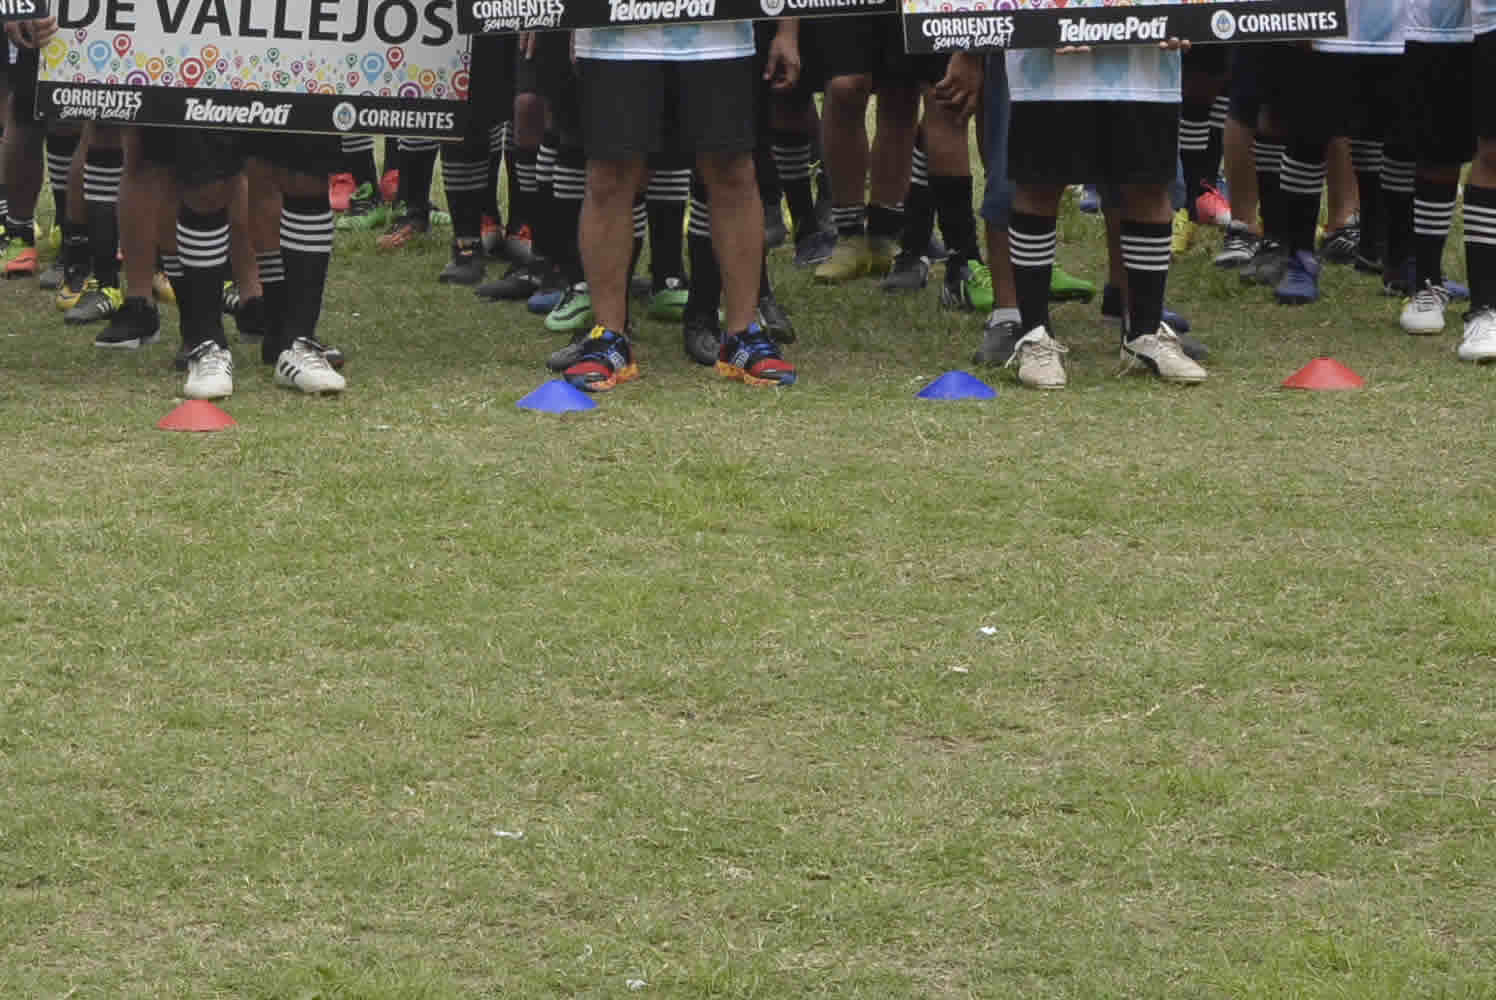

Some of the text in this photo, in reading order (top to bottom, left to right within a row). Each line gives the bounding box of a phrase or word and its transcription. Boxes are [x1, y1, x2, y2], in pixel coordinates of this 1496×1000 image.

[922, 15, 1014, 37] CORRIENTES
[1237, 11, 1339, 33] CORRIENTES
[52, 86, 142, 108] CORRIENTES
[358, 108, 454, 130] CORRIENTES
